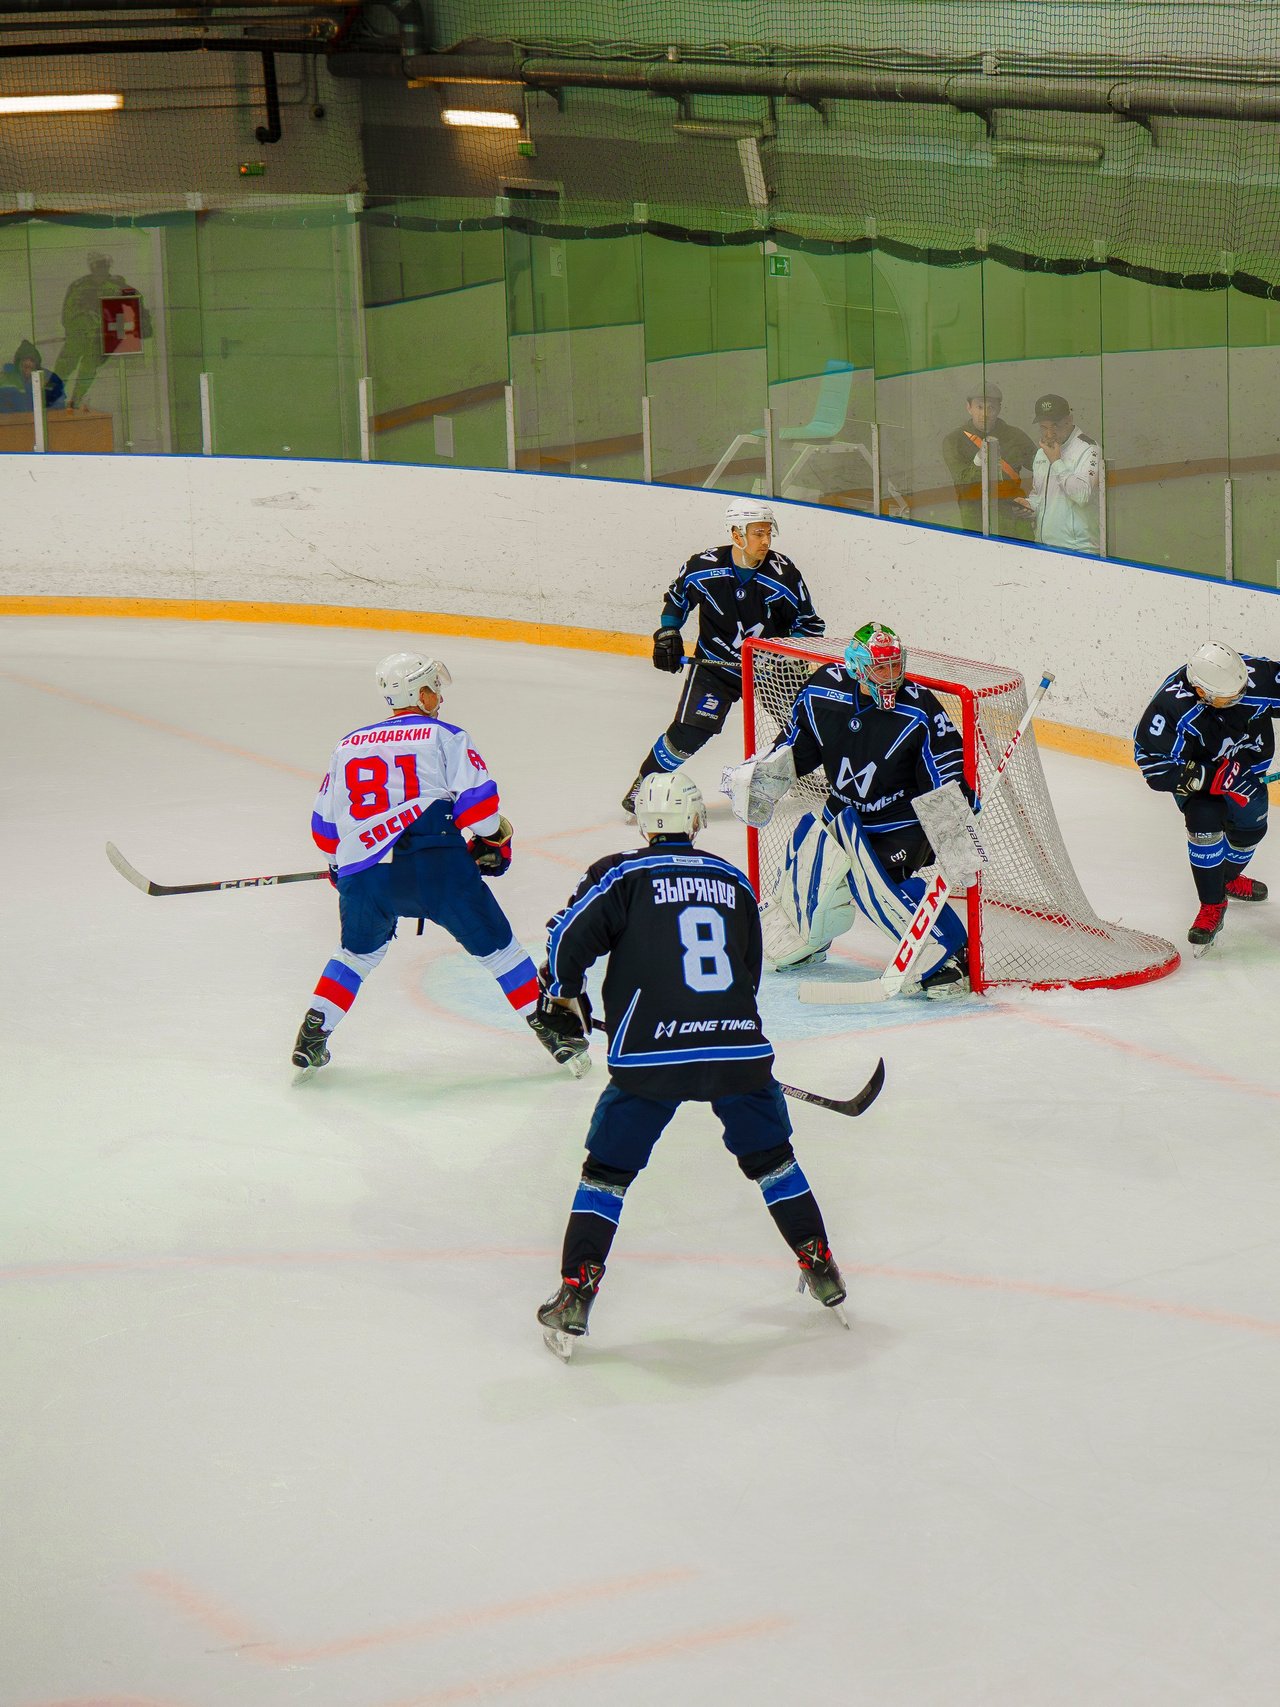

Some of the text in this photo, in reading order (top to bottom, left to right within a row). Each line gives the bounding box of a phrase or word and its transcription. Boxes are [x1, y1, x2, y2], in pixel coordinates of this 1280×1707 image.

[883, 693, 896, 710] 35
[1149, 713, 1166, 736] 9
[996, 730, 1021, 774] CCM
[344, 753, 421, 821] 81
[359, 804, 423, 850] SOCHI
[657, 818, 664, 829] 8
[965, 825, 989, 863] BAUER
[220, 876, 279, 890] CCM
[652, 877, 736, 910] ЗЫРЯНОВ
[893, 874, 948, 973] CCM
[677, 905, 735, 993] 8
[679, 1020, 719, 1034] ONE
[780, 1084, 809, 1101] TIMER
